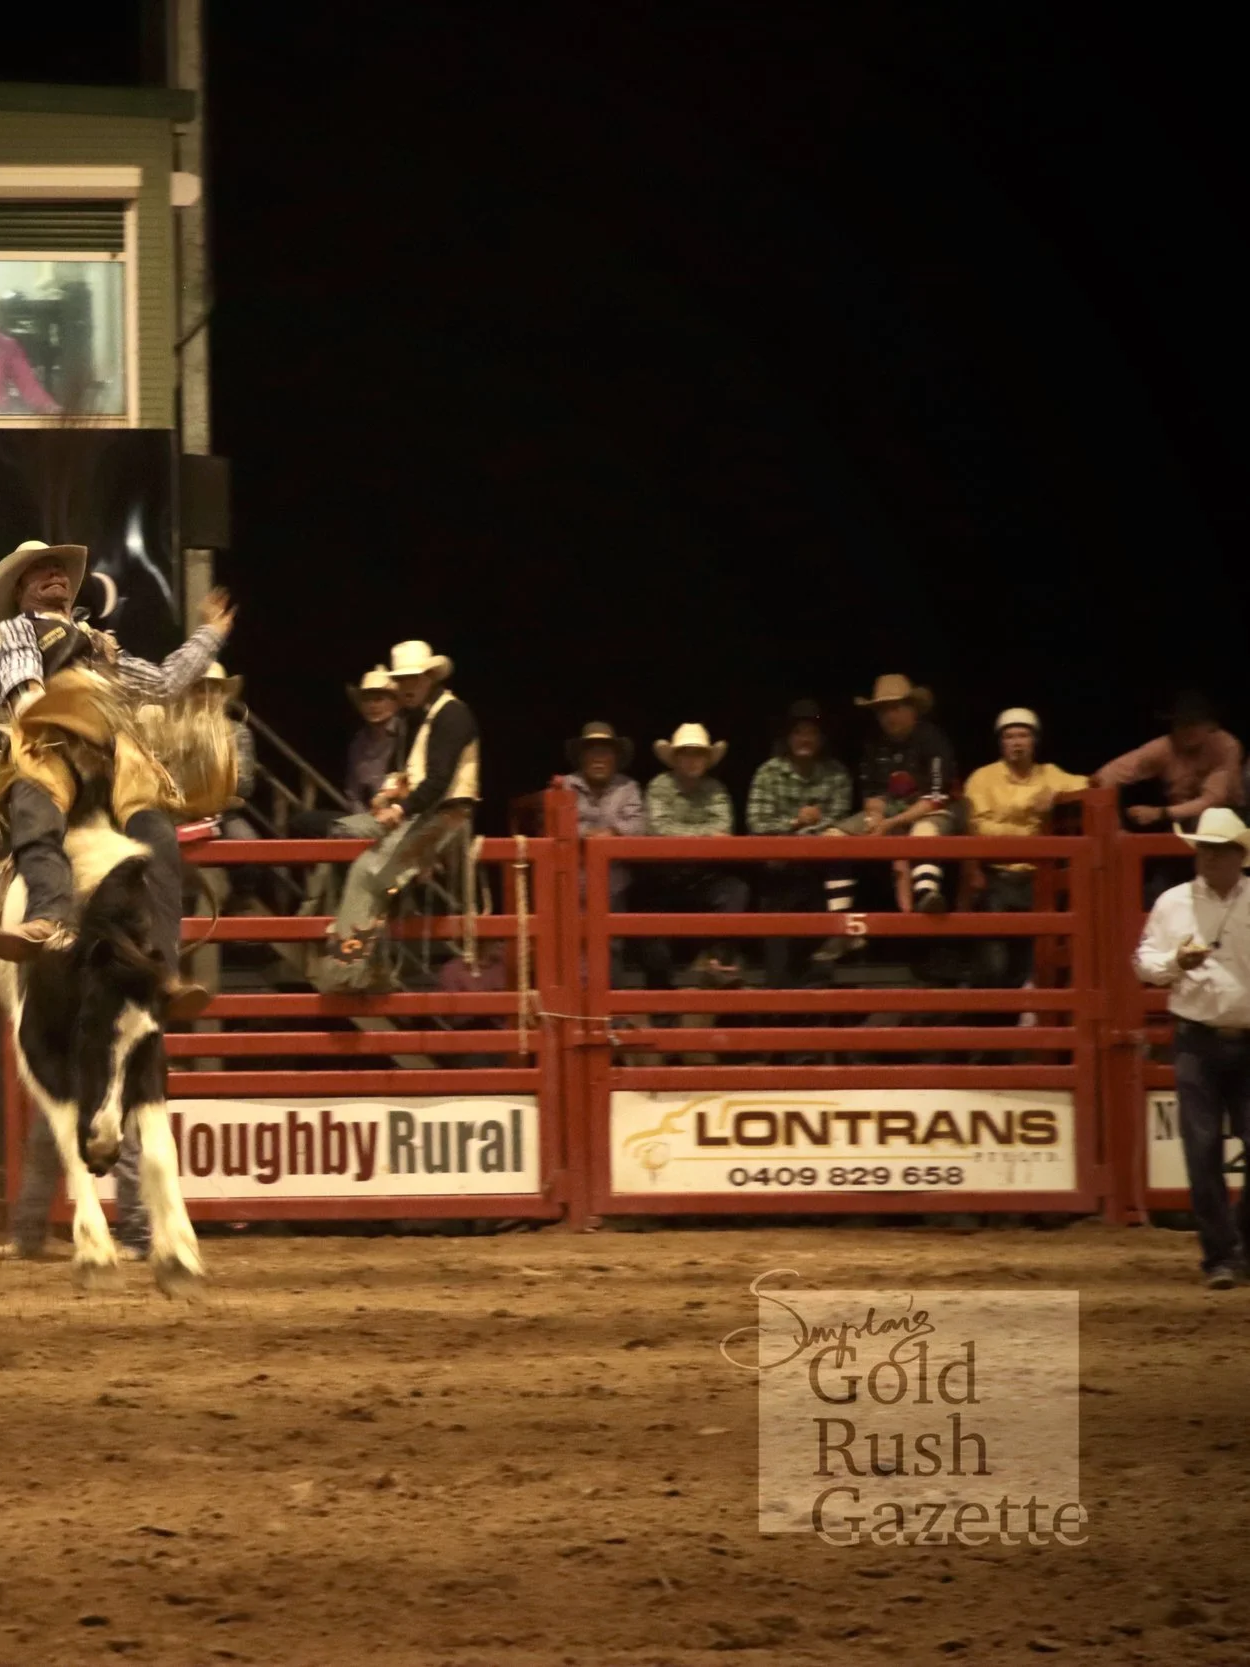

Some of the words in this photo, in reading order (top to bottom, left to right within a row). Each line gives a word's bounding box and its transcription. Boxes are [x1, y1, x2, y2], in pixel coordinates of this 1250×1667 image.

[845, 913, 868, 936] 5
[696, 1110, 1059, 1146] LONTRANS
[728, 1168, 818, 1187] 0409
[828, 1168, 891, 1186] 829
[902, 1167, 966, 1186] 658
